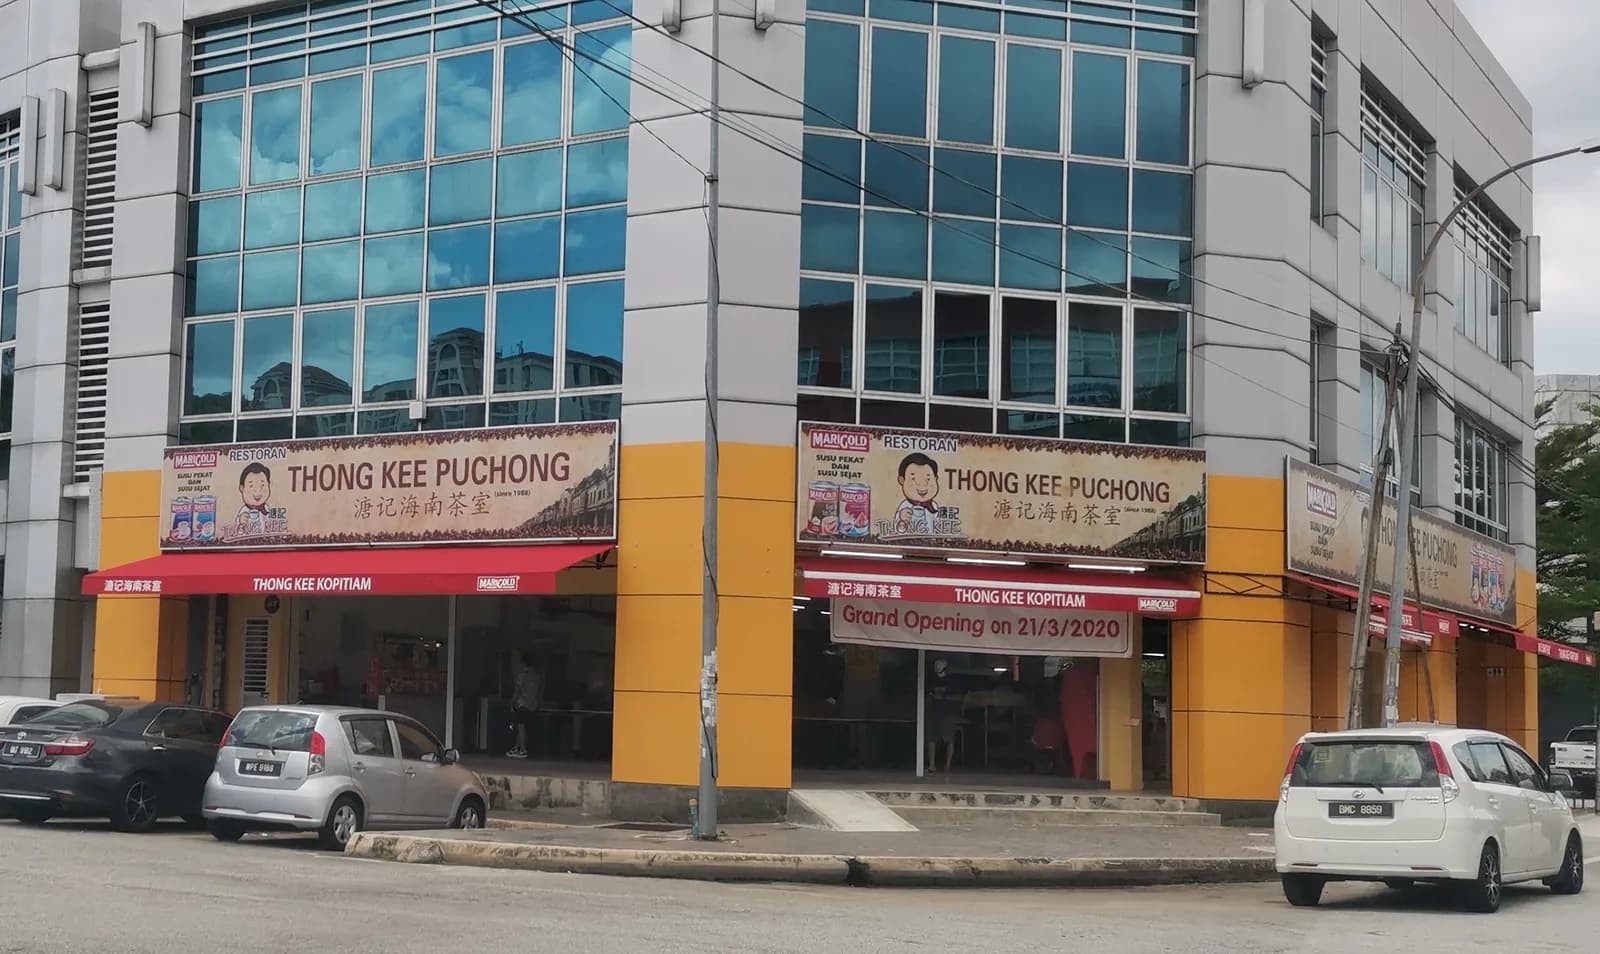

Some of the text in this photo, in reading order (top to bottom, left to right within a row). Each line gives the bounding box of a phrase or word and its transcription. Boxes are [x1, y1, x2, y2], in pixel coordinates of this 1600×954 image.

[813, 432, 867, 450] MARIGOLD
[884, 435, 957, 452] RESTORAN
[175, 453, 216, 468] MARIGOLD
[229, 447, 287, 461] RESTORAN
[816, 455, 864, 464] SUSU PEKAT
[288, 452, 570, 492] THONG KEE PUCHONG
[839, 471, 862, 479] SEJAT
[944, 468, 1170, 504] THONG KEE PUCHONG
[354, 491, 491, 520] 溏记海南茶室
[993, 500, 1121, 527] 溏记海南茶室
[874, 519, 961, 536] THONG KEE
[1422, 530, 1458, 569] PUCHONG
[253, 576, 372, 591] THONG KEE KOPITIAM
[954, 588, 1086, 608] THONG KEE KOPITIAM
[1140, 599, 1175, 611] MARIGOLD
[842, 604, 1121, 638] Grand Opening on 21/3/2020
[1339, 805, 1356, 815] BMC
